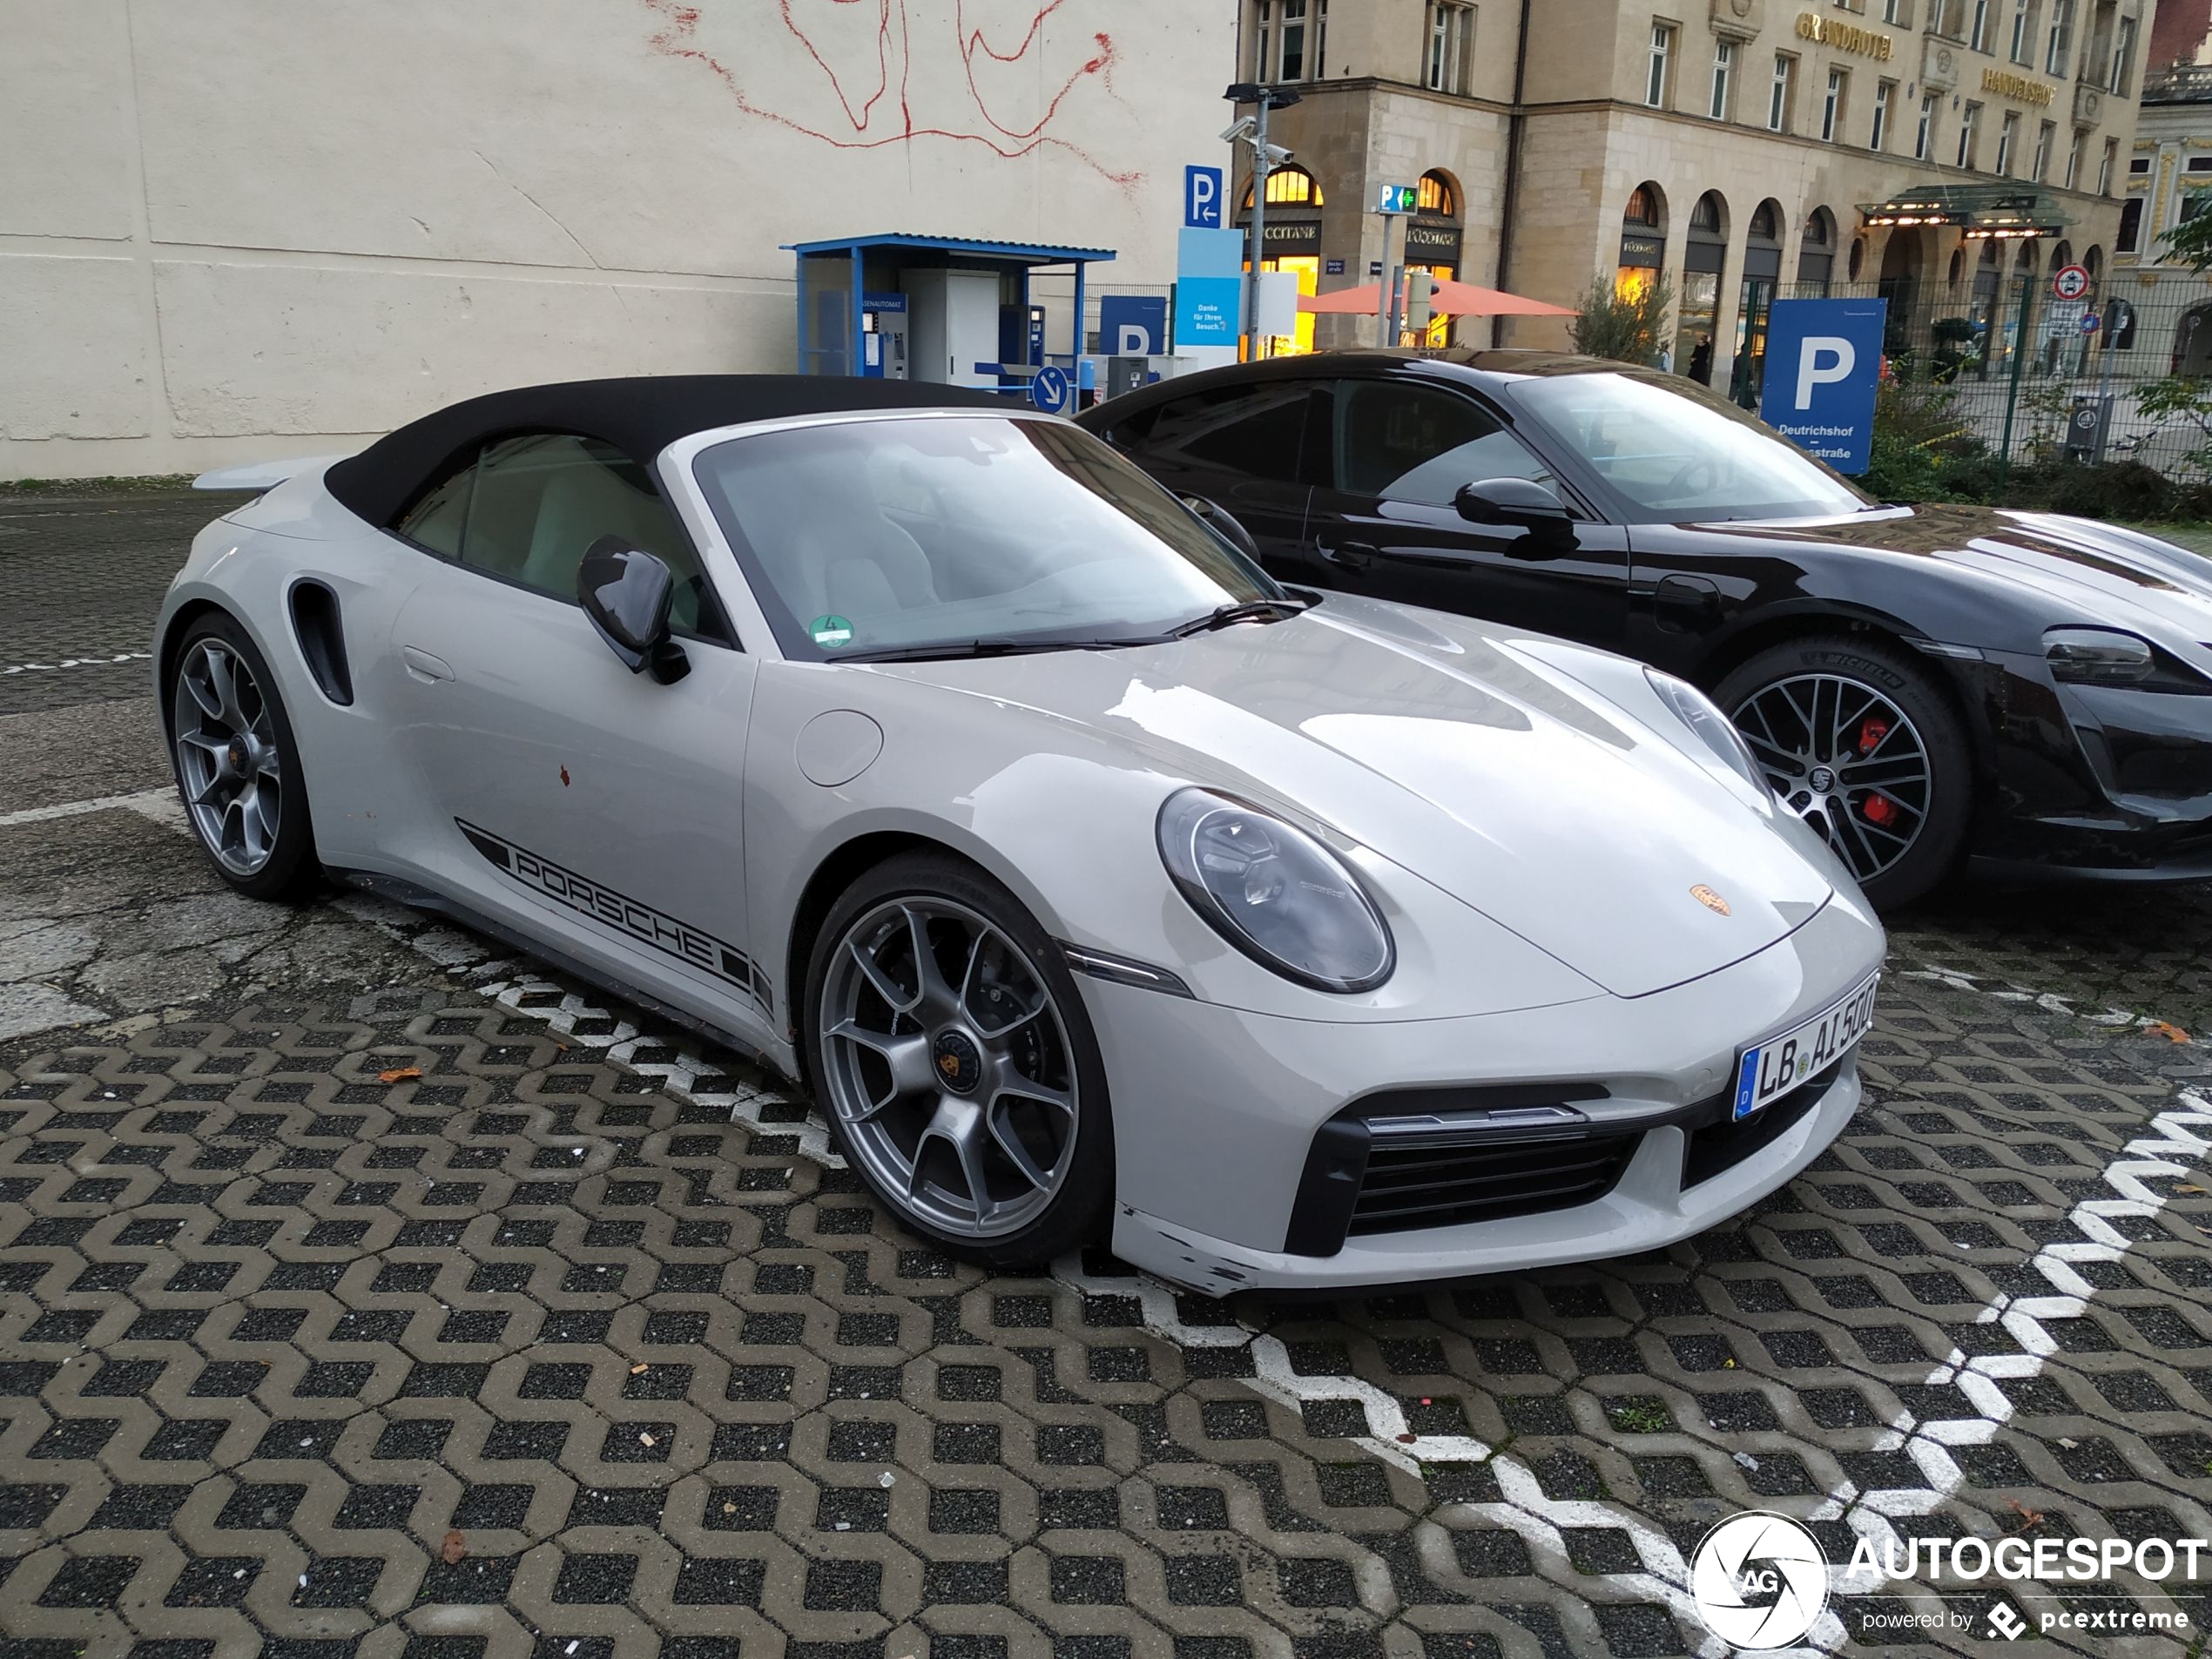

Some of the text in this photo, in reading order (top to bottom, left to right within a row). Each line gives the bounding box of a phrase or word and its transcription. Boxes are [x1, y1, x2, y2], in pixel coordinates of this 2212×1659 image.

[1797, 12, 1894, 60] GRANDHOTEL
[1981, 68, 2056, 105] HANDELSHOF
[1193, 173, 1214, 220] P
[1381, 185, 1393, 206] P
[1244, 226, 1316, 240] LCCITANE
[1118, 325, 1150, 355] P
[1795, 337, 1855, 410] P
[1779, 424, 1853, 437] Deutrichshof
[1804, 447, 1851, 459] sstraße
[825, 617, 837, 631] 4
[516, 853, 715, 967] PORSCHE
[1758, 981, 1875, 1100] LB AI 500
[1742, 1090, 1750, 1105] D
